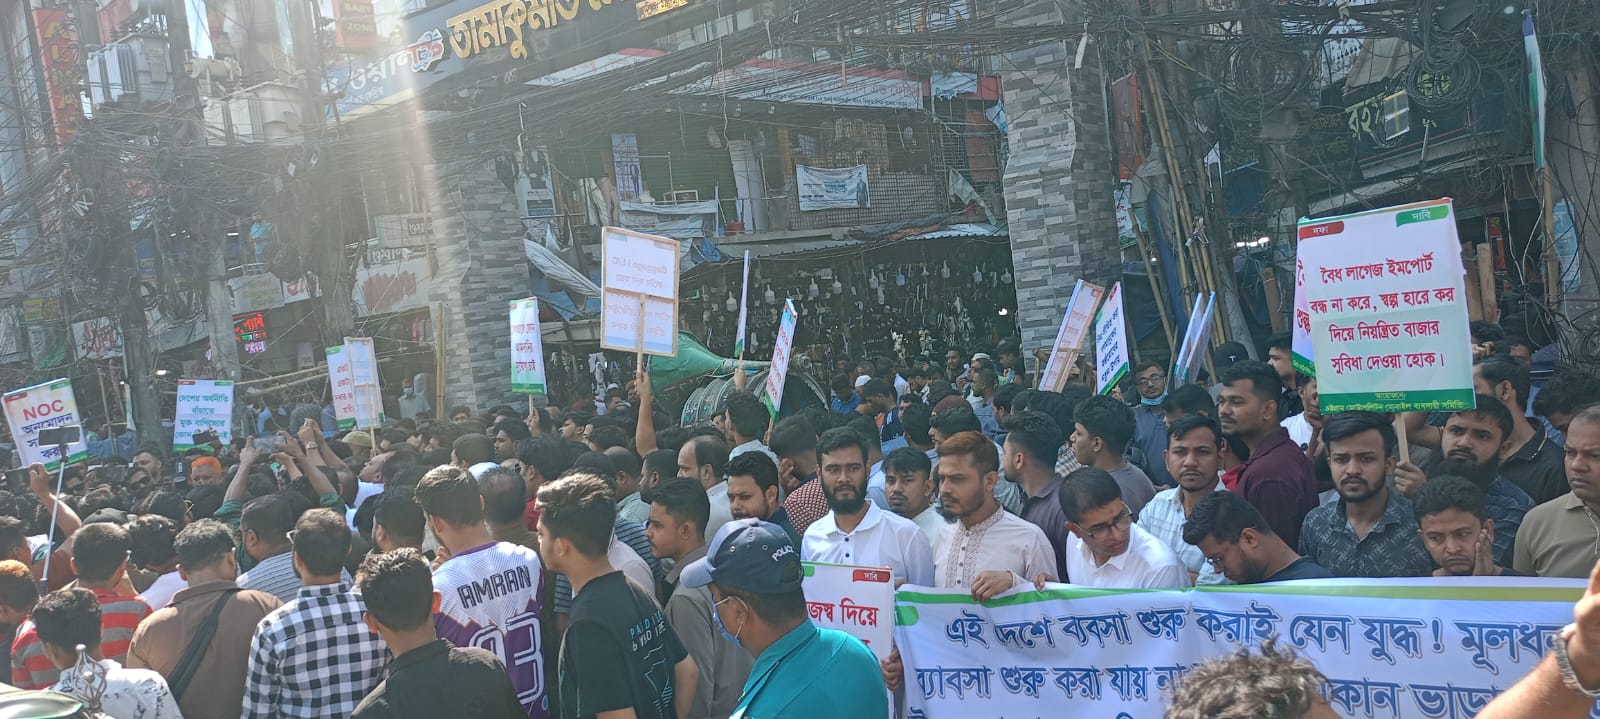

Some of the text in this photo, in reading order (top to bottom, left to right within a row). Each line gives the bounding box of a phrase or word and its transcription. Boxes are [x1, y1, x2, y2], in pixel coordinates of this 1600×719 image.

[345, 22, 375, 33] ZONE
[1411, 208, 1431, 220] দাবি
[1320, 265, 1343, 284] বৈধ
[1345, 262, 1384, 282] লাগেজ
[1386, 252, 1434, 276] ইমপোর্ট
[1309, 299, 1328, 315] বন্ধ
[1331, 298, 1343, 312] না
[1379, 290, 1399, 310] স্বল্প
[1402, 289, 1430, 307] হারে
[1434, 286, 1456, 304] কর
[1328, 320, 1440, 344] দিয়ে নিয়ন্ত্রিত বাজার
[1331, 352, 1364, 376] সুবিধা
[1366, 353, 1401, 371] দেওয়া
[23, 399, 65, 421] NOC
[21, 413, 73, 434] অনমোদন
[457, 565, 532, 609] AMRAN
[863, 571, 878, 581] দাবি
[806, 597, 880, 627] জস্ব দিয়ে
[946, 611, 989, 648] এই
[1058, 611, 1131, 647] ব্যবসা
[1136, 608, 1187, 641] শুরু
[1193, 602, 1280, 646] করাই
[1290, 615, 1355, 653] যেন
[1359, 616, 1426, 665] যুদ্ধ
[915, 665, 993, 700] ব্যাবসা
[1000, 666, 1047, 700] শুরু
[1053, 665, 1104, 701] করা
[1106, 664, 1151, 701] যায়
